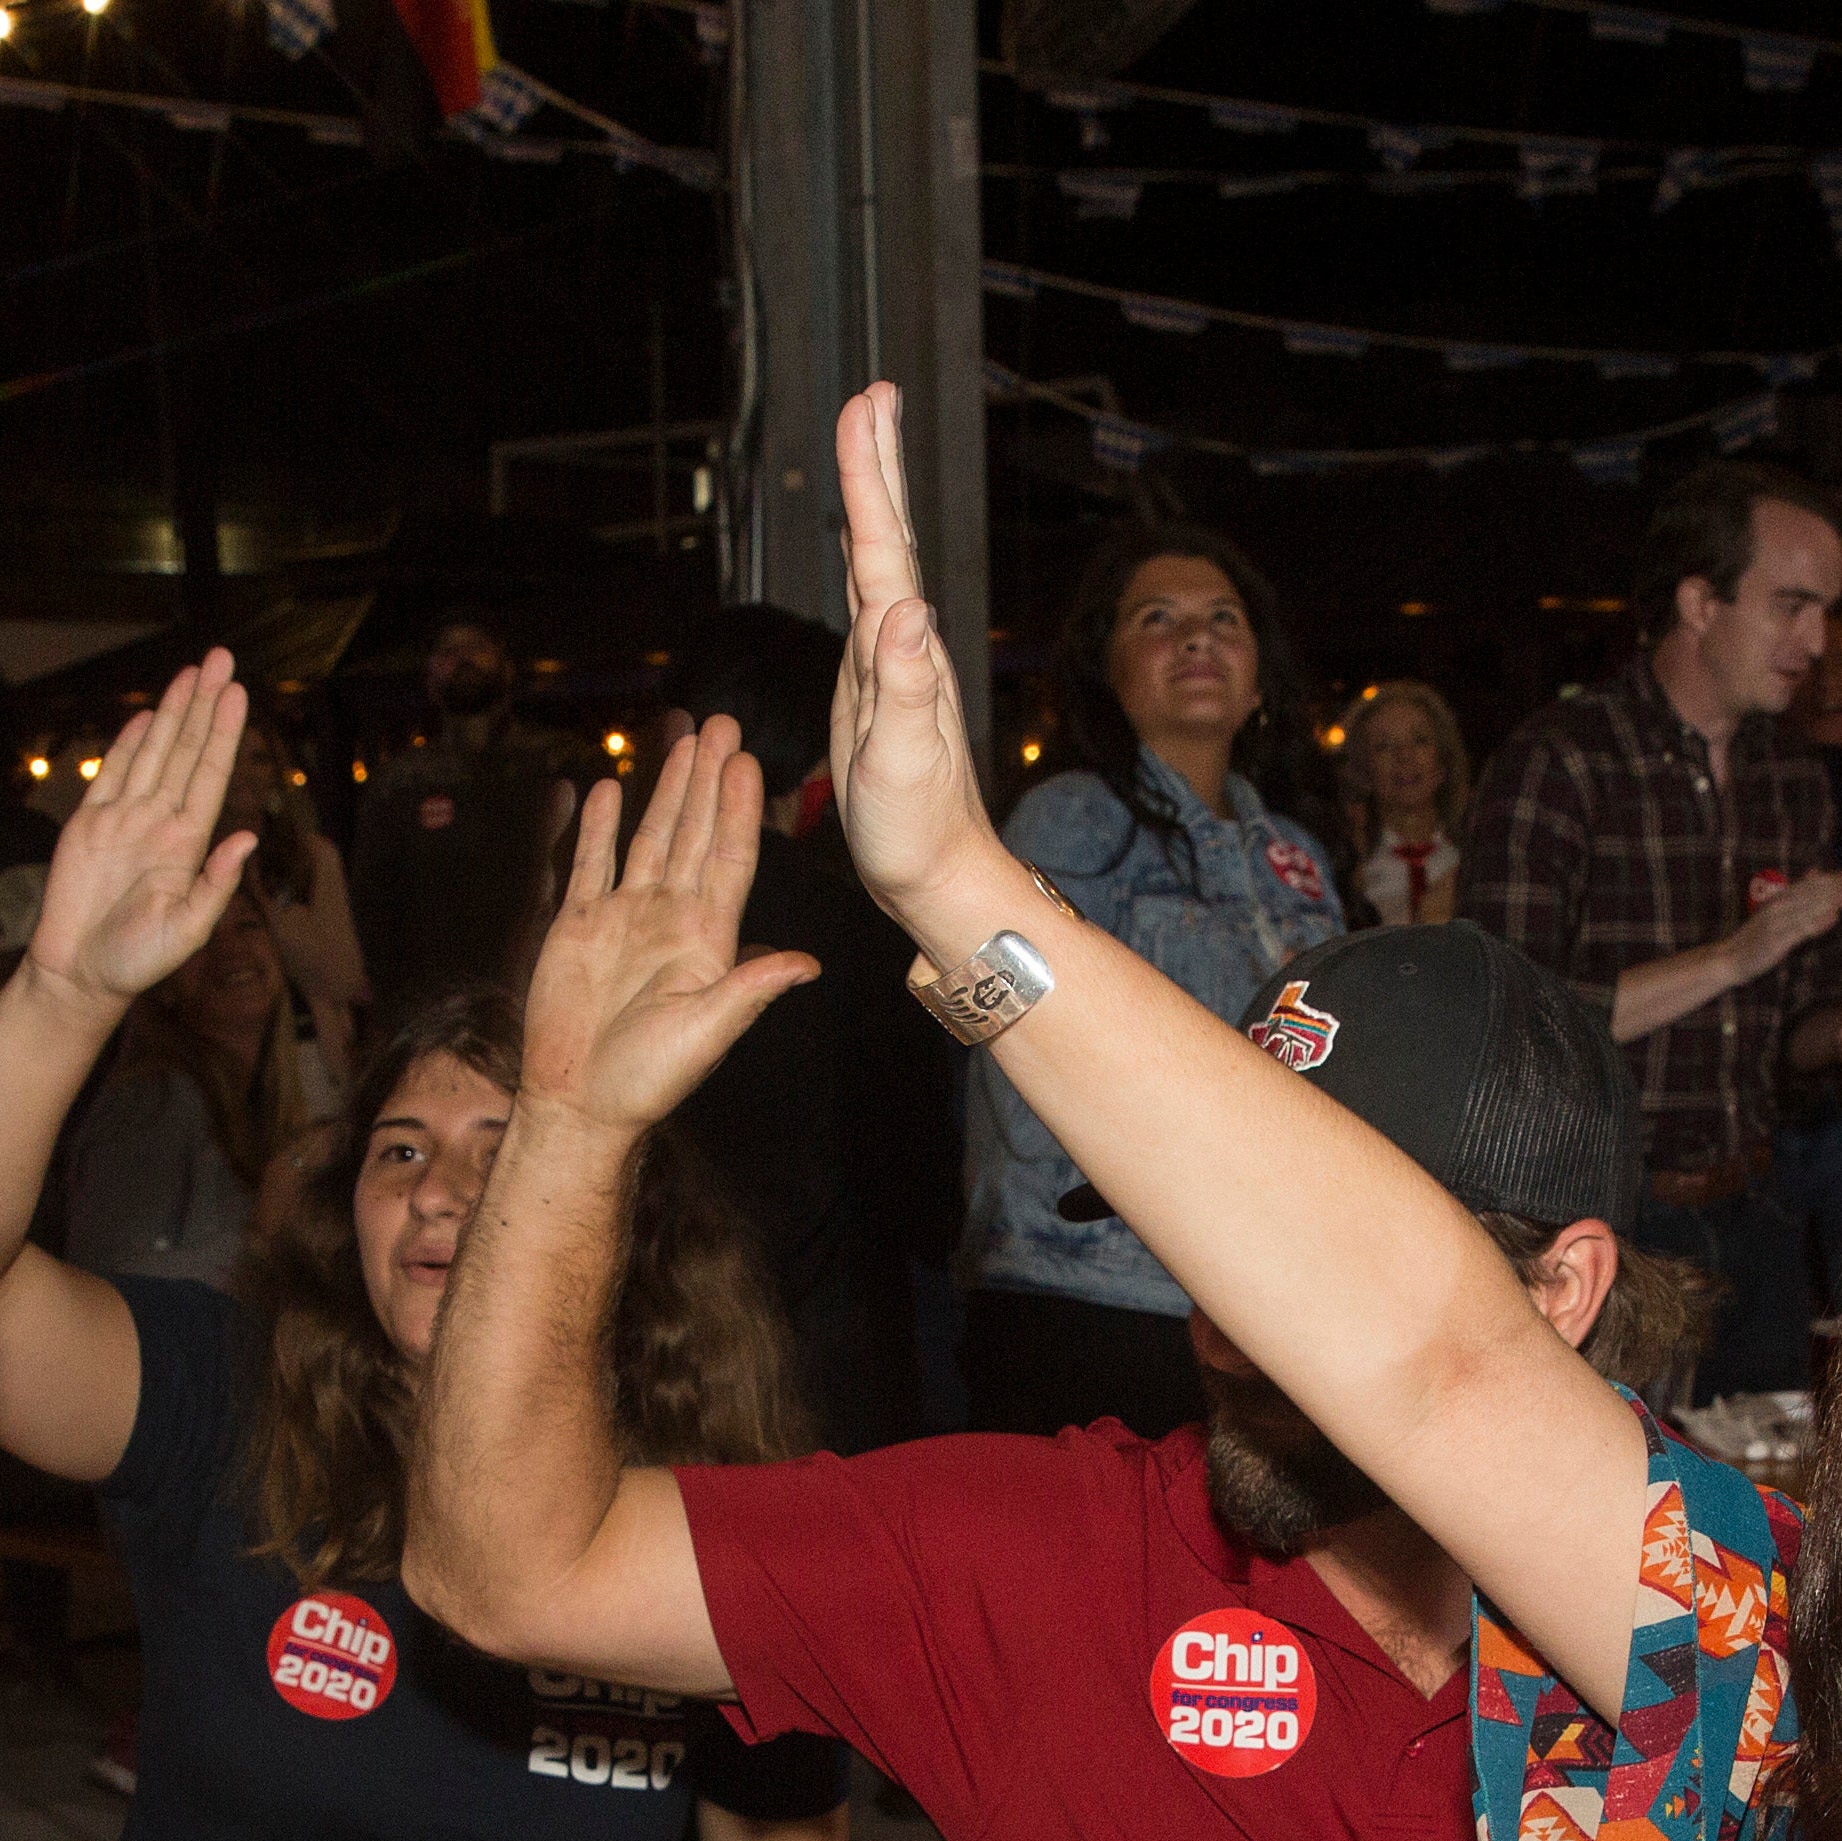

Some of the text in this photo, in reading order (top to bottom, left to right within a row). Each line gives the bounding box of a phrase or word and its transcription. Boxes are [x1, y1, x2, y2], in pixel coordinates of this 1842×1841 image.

[290, 1600, 391, 1664] Chip
[1171, 1631, 1299, 1690] Chip
[274, 1654, 378, 1711] 2020
[1171, 1690, 1299, 1712] for congress
[1169, 1705, 1299, 1751] 2020
